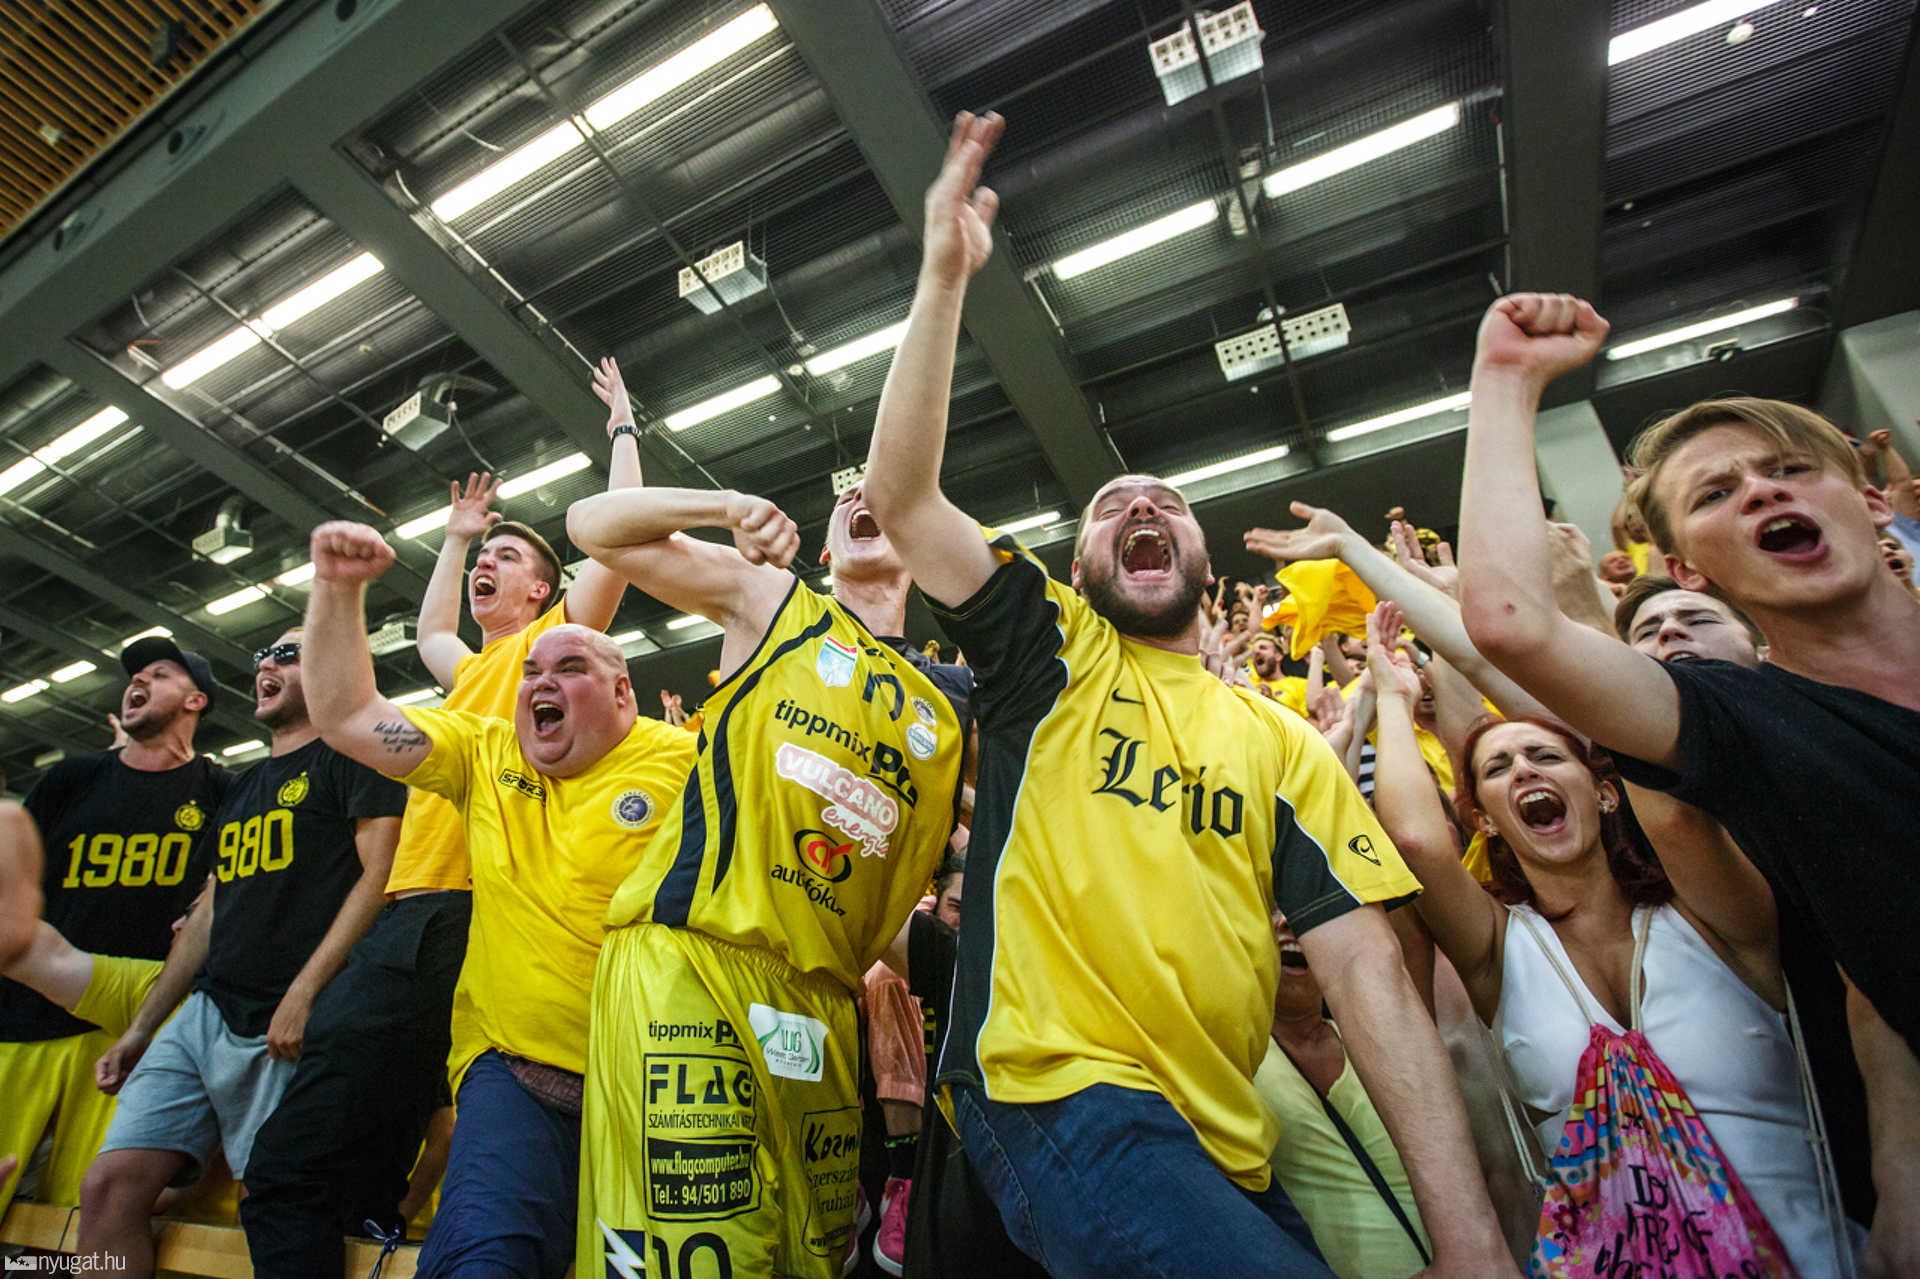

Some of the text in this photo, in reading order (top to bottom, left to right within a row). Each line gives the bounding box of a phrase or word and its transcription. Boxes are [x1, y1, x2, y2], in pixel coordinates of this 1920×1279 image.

[785, 751, 894, 825] VULCANO
[1091, 728, 1243, 839] Leio
[62, 833, 192, 889] 1980
[216, 808, 294, 884] 980
[649, 1063, 752, 1107] FLAG
[650, 1146, 750, 1181] www.flagcomputer.hu
[652, 1178, 751, 1206] Tel.: 94/501 890
